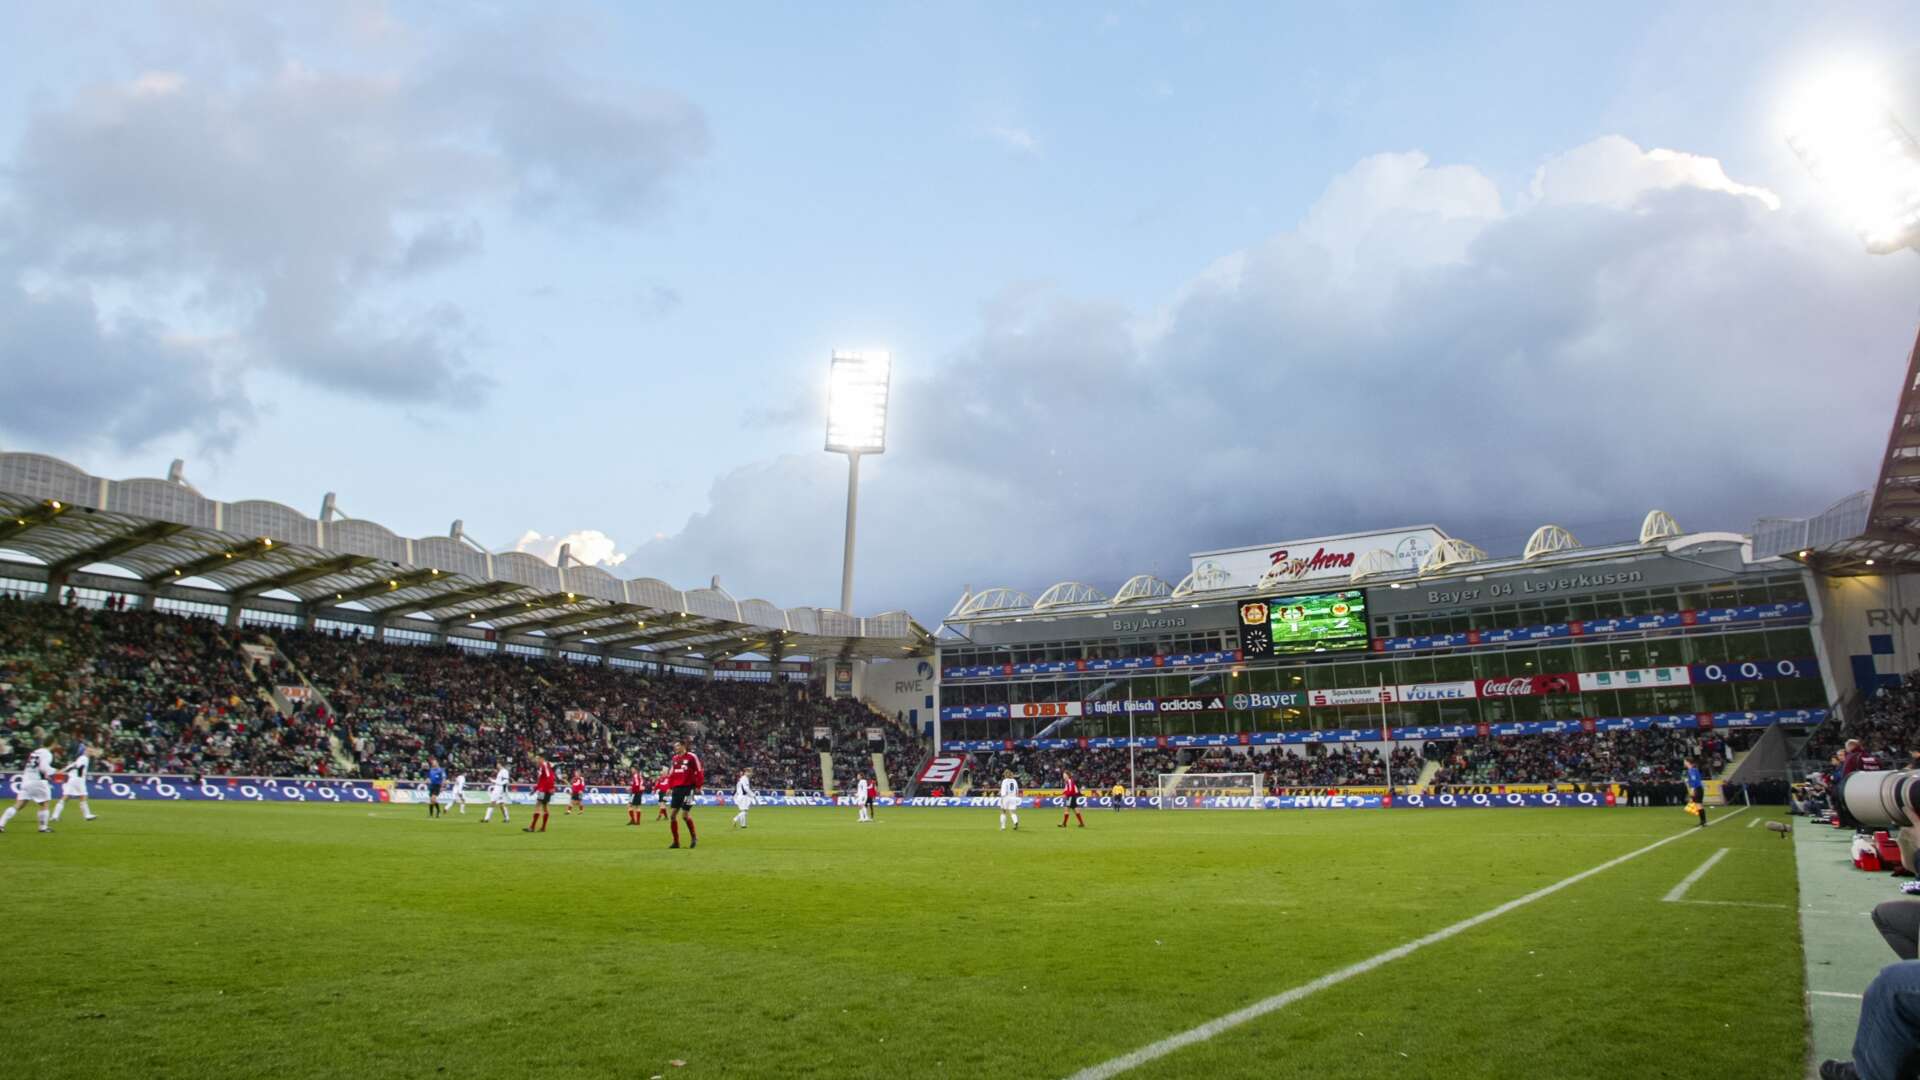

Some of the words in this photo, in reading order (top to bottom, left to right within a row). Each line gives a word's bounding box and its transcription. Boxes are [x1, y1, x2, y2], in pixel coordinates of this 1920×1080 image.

[1427, 588, 1481, 604] Bayer
[1490, 583, 1514, 596] 04
[1523, 569, 1643, 594] Leverkusen
[1112, 617, 1186, 632] BayArena
[895, 680, 923, 693] RWE
[1094, 700, 1120, 713] Gaffel
[1160, 699, 1203, 711] adidas
[1251, 693, 1296, 709] Bayer
[1023, 703, 1068, 717] OBI
[591, 793, 629, 804] RWE
[783, 796, 817, 805] RWE
[911, 796, 950, 806] RWE
[1215, 796, 1259, 807] RWE
[1294, 795, 1345, 807] RWE
